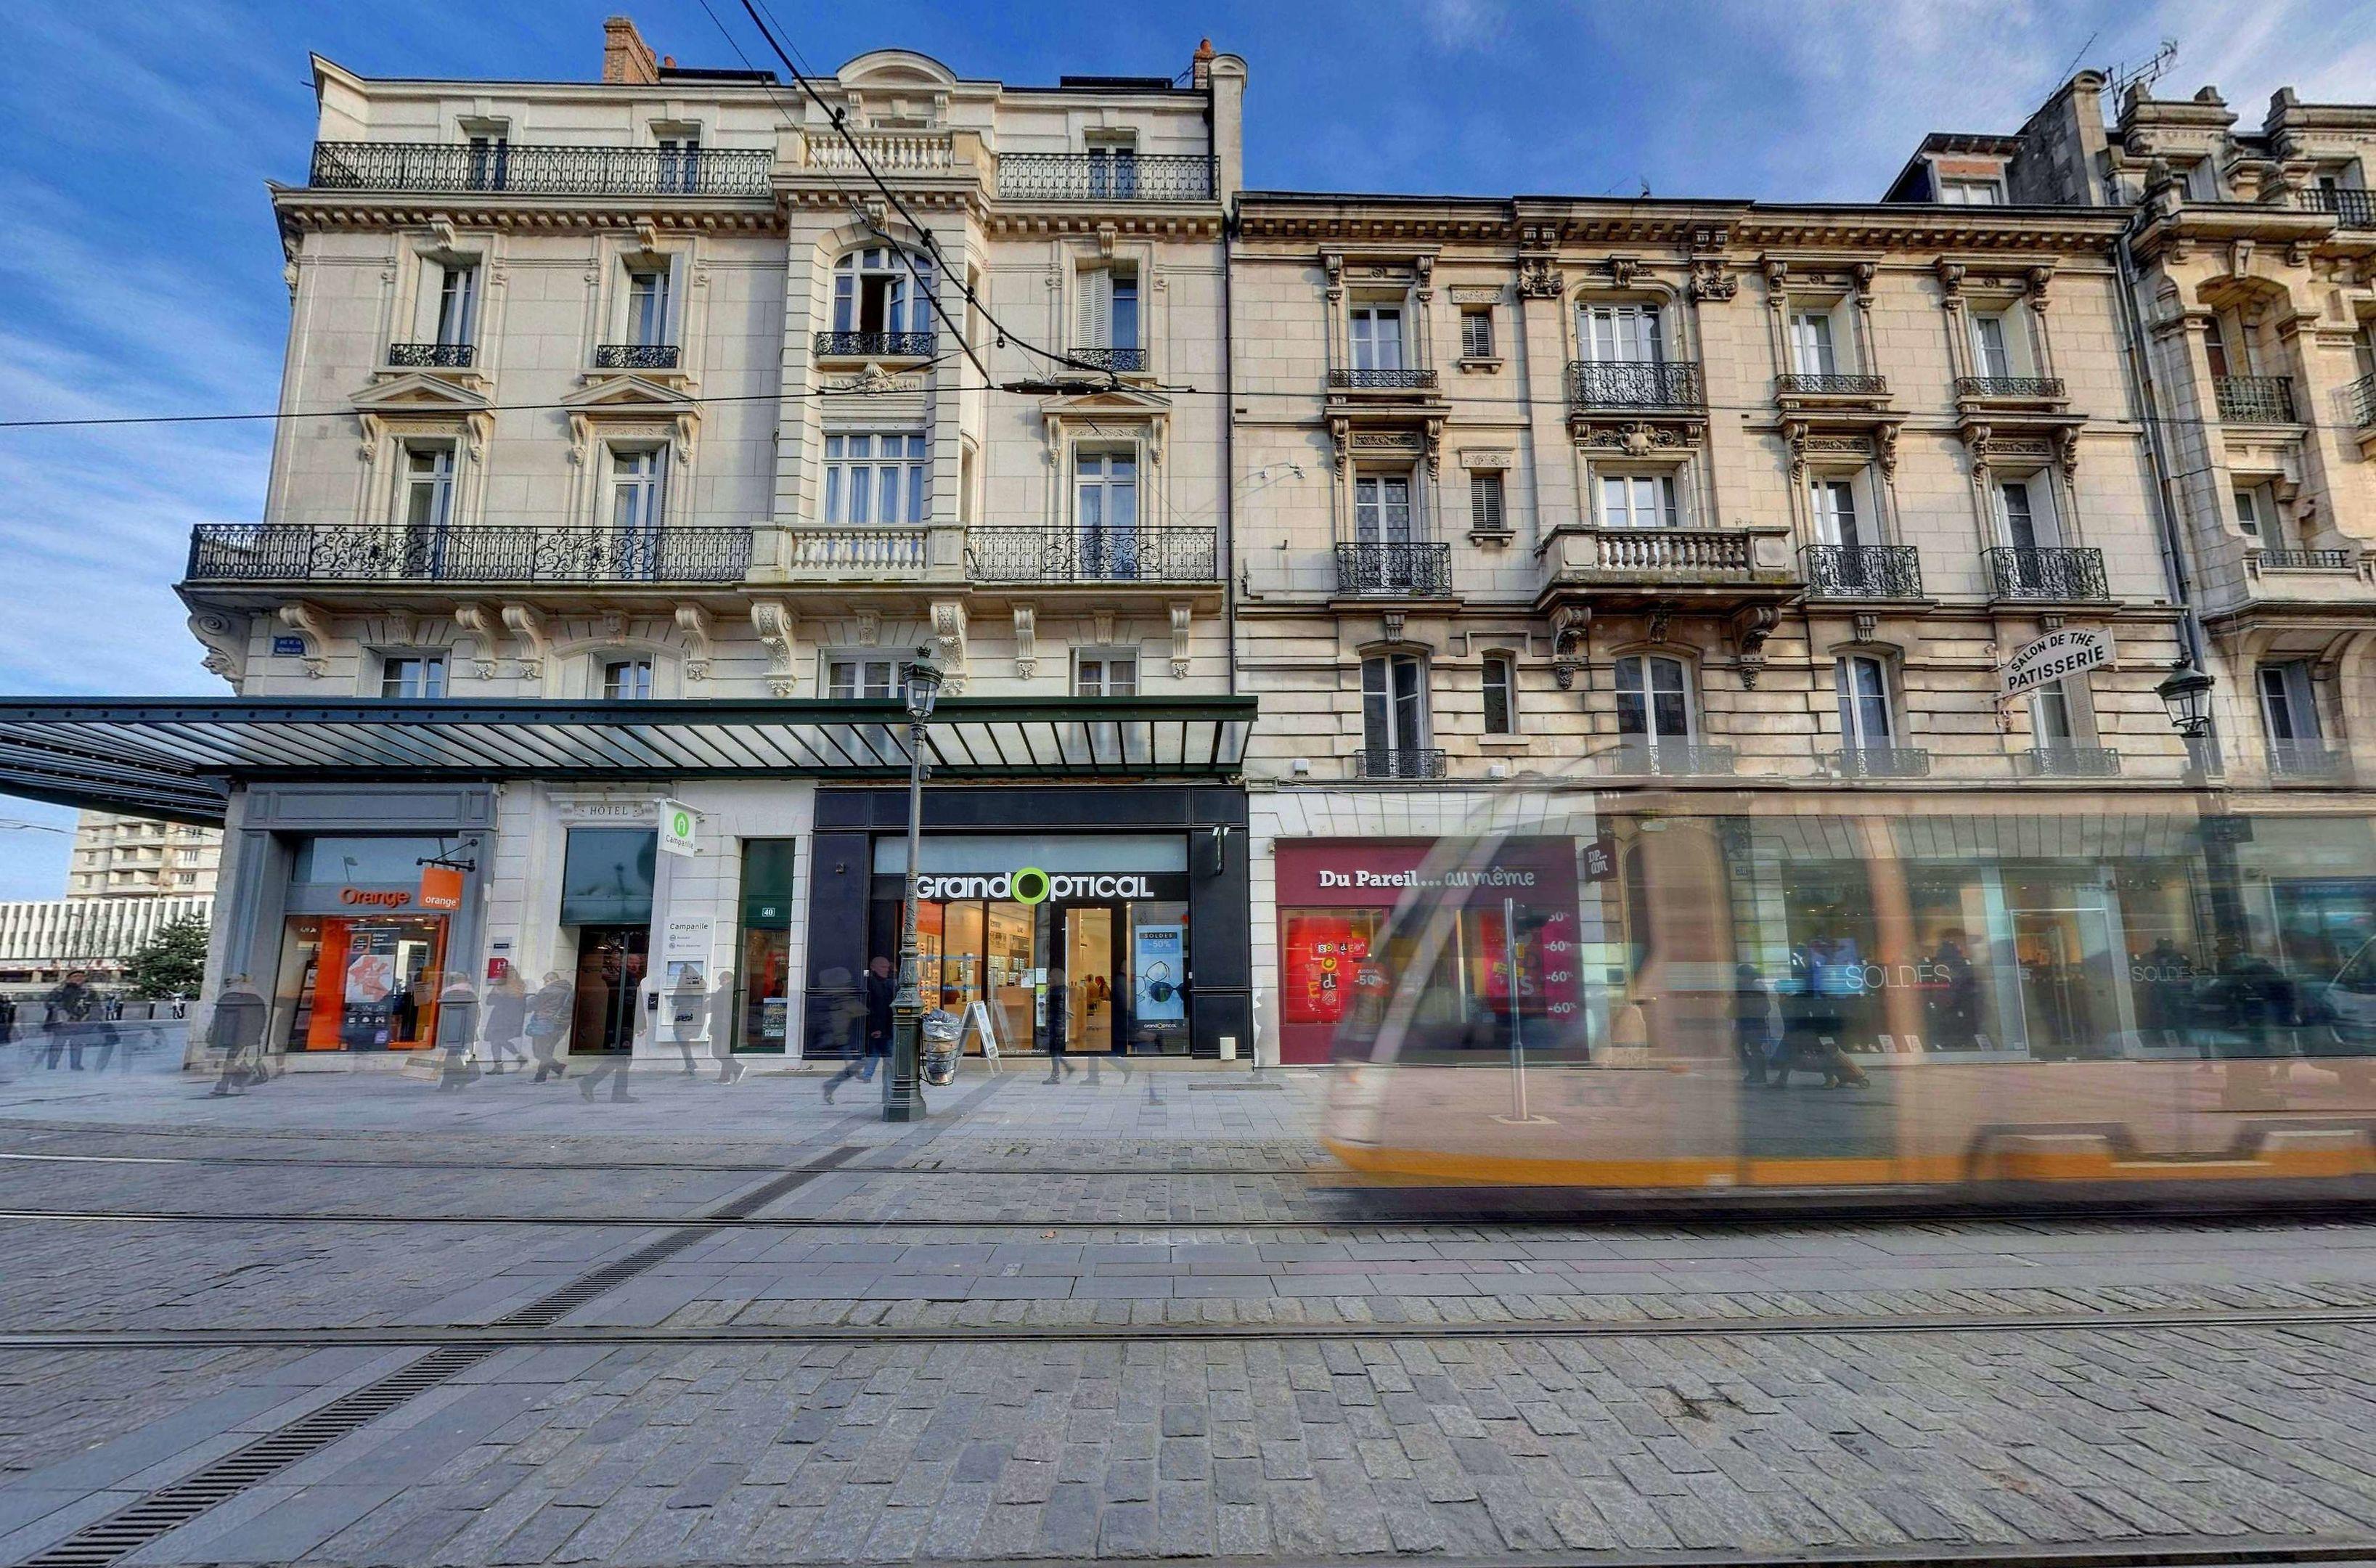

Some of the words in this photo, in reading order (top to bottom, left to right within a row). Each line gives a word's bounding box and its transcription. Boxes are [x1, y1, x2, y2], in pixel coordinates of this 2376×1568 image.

[2011, 641, 2046, 672] SALON
[2050, 634, 2065, 648] DE
[2070, 632, 2096, 647] THE
[2008, 645, 2104, 690] PATISSERIE
[665, 835, 695, 849] Campanile
[1320, 870, 1351, 887] Du
[1445, 871, 1469, 887] au
[1473, 866, 1535, 887] même
[1591, 859, 1609, 875] am
[340, 886, 412, 908] Orange
[425, 895, 457, 907] orange
[669, 923, 709, 932] Campanile
[1845, 964, 1951, 989] SOLDES
